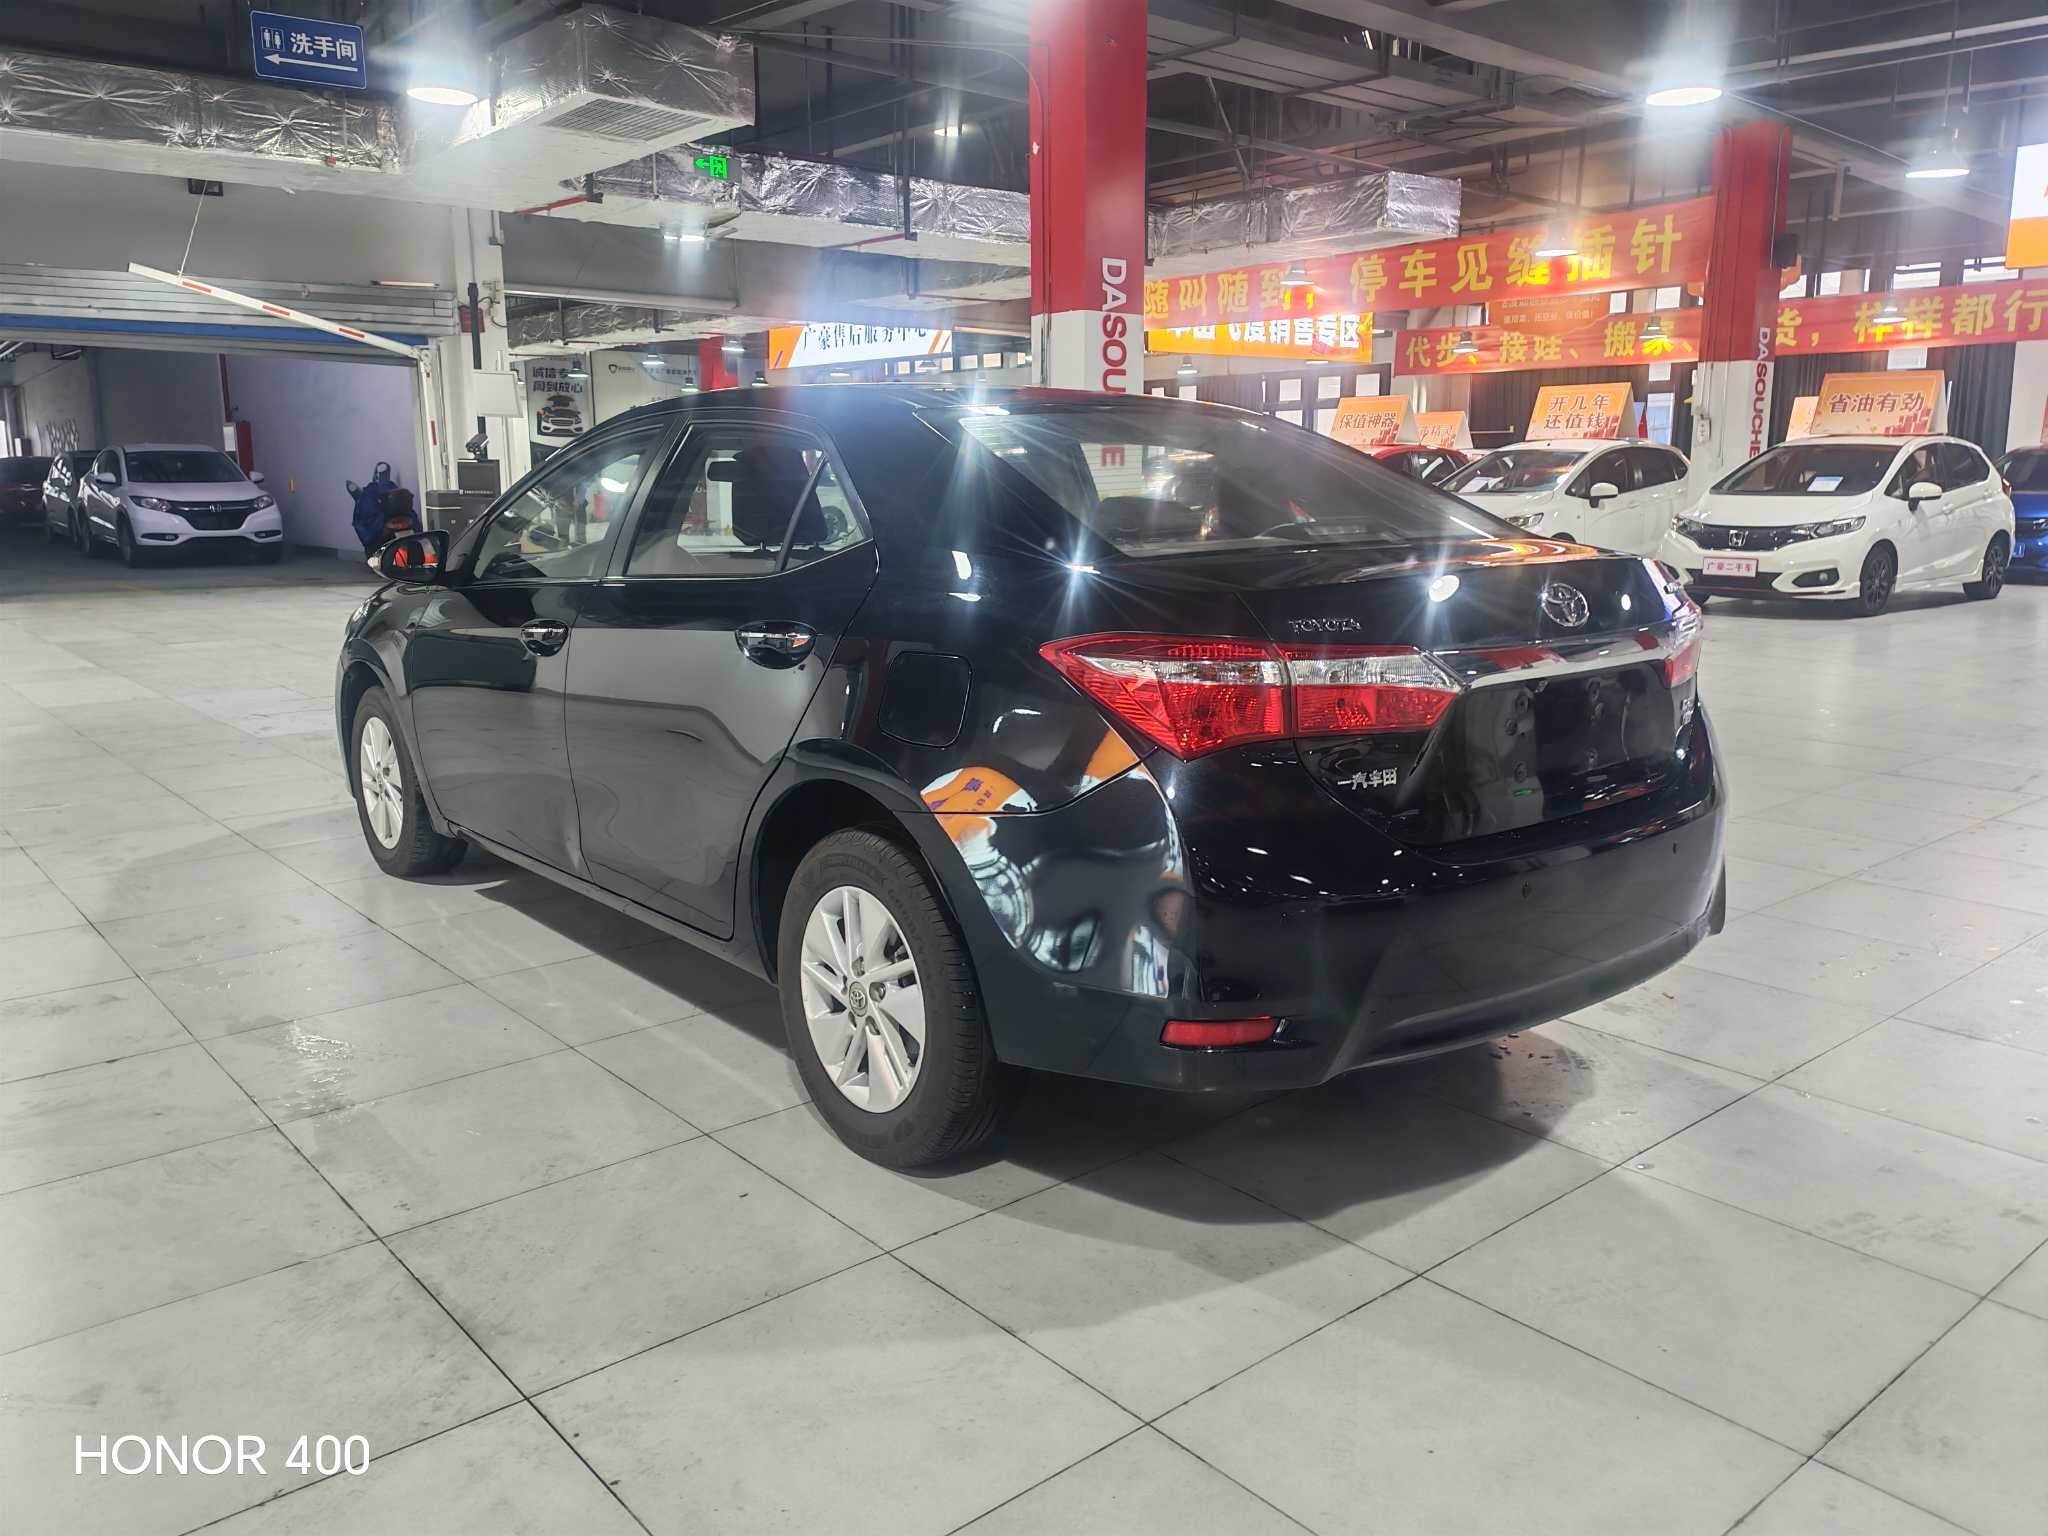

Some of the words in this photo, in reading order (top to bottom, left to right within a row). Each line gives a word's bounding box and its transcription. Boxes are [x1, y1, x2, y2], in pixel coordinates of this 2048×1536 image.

[290, 32, 357, 61] 洗手间
[1749, 327, 1770, 459] DASOUCHE
[1829, 392, 1926, 413] 省油有劲
[1550, 394, 1611, 412] 开几年
[1339, 411, 1397, 429] 保值神器
[1544, 412, 1606, 430] 还值钱
[1288, 618, 1361, 632] TOYOTA
[1337, 768, 1397, 790] 一汽丰田
